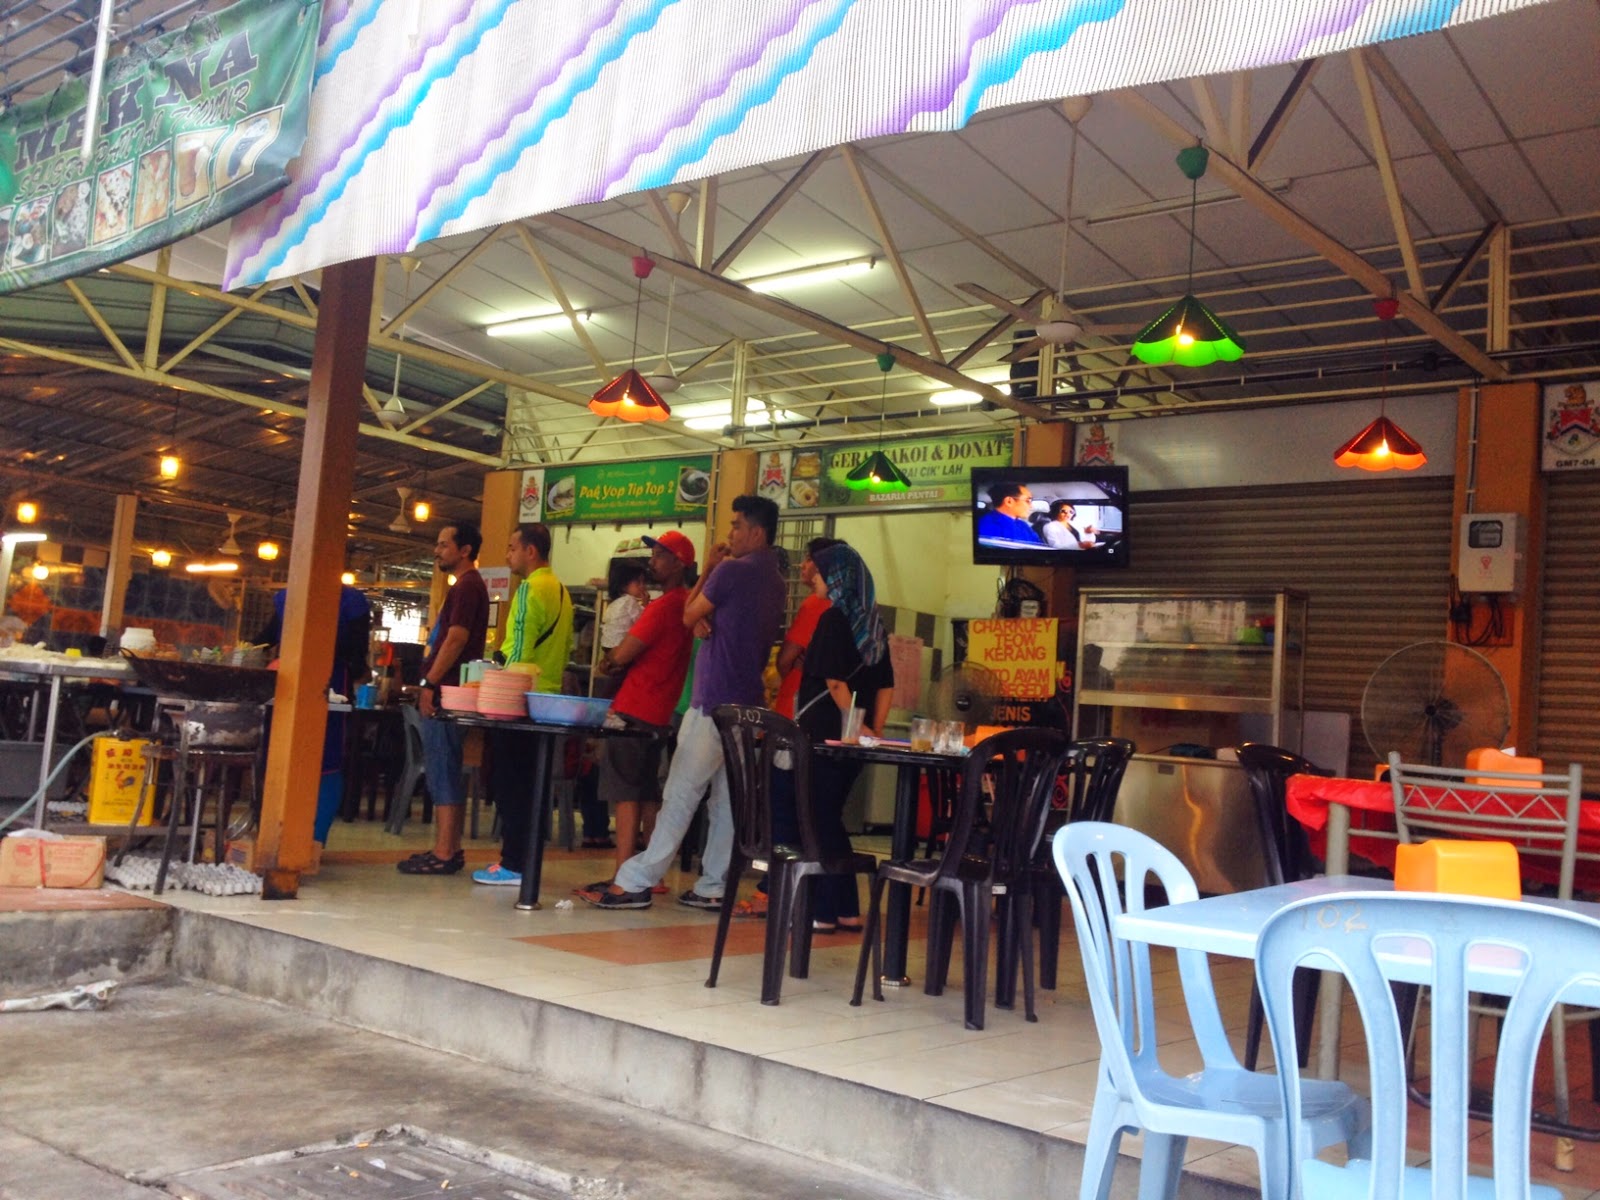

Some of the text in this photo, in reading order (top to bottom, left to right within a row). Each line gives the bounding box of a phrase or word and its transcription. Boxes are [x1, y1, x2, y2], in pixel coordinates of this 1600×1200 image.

[153, 29, 259, 106] NA
[931, 444, 944, 461] &
[948, 439, 1005, 460] DONAT
[942, 463, 964, 475] LAH
[1555, 458, 1596, 468] GM7-04
[579, 485, 601, 500] Pak
[602, 484, 625, 500] Yop
[628, 482, 644, 497] Tip
[646, 481, 665, 496] Top
[907, 490, 938, 499] PANTAI
[972, 619, 1053, 634] CHARKUEY
[994, 633, 1037, 647] TEOW
[984, 646, 1047, 662] KERANG
[1014, 669, 1050, 682] AYAM
